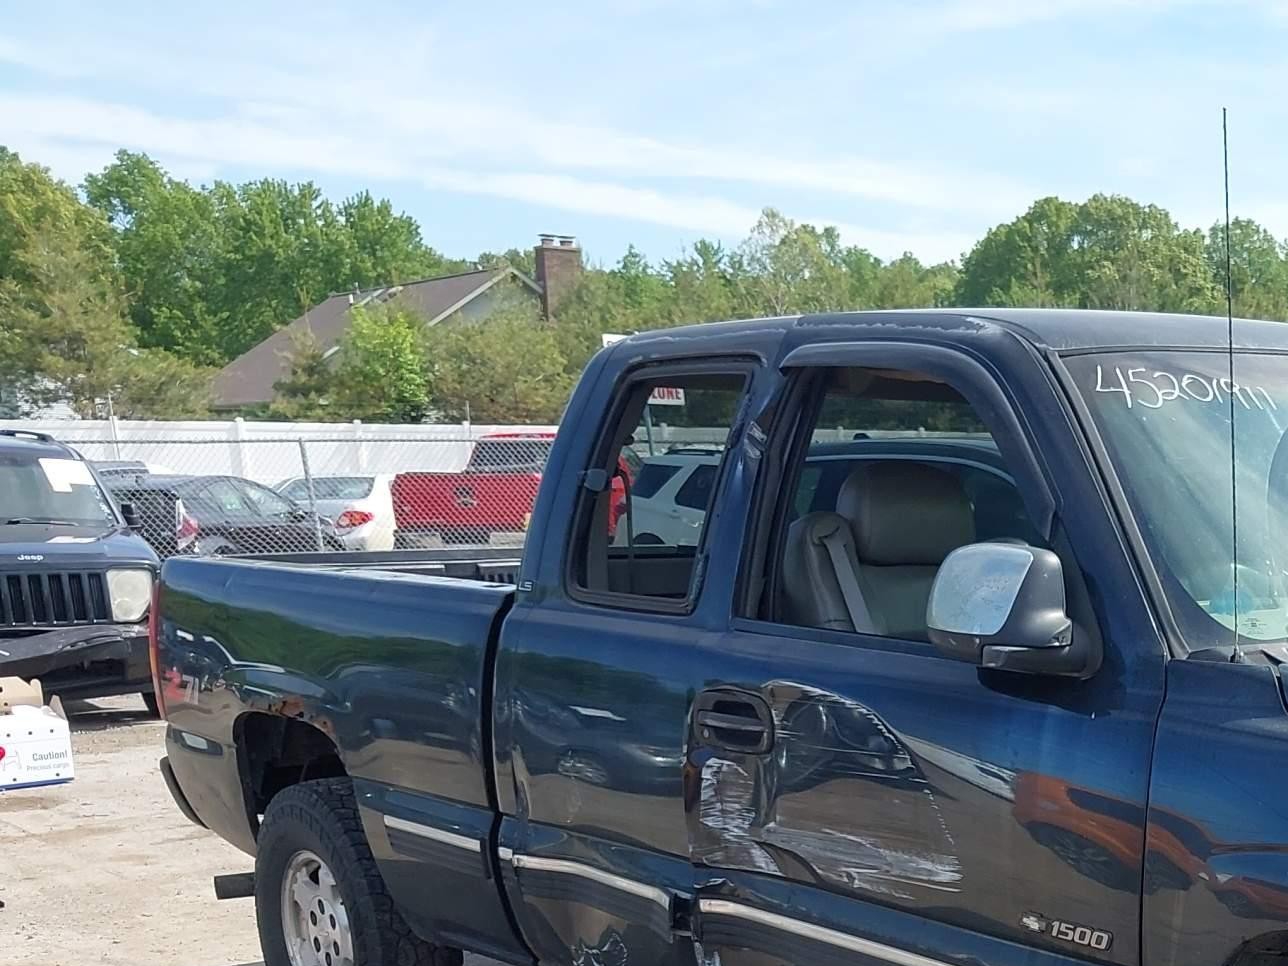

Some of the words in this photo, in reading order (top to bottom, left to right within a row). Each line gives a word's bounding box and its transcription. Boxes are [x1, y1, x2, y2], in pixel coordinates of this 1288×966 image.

[1095, 364, 1277, 409] 45201911
[17, 554, 44, 562] Jeep
[32, 749, 68, 761] Caution!
[1051, 920, 1109, 950] 1500
